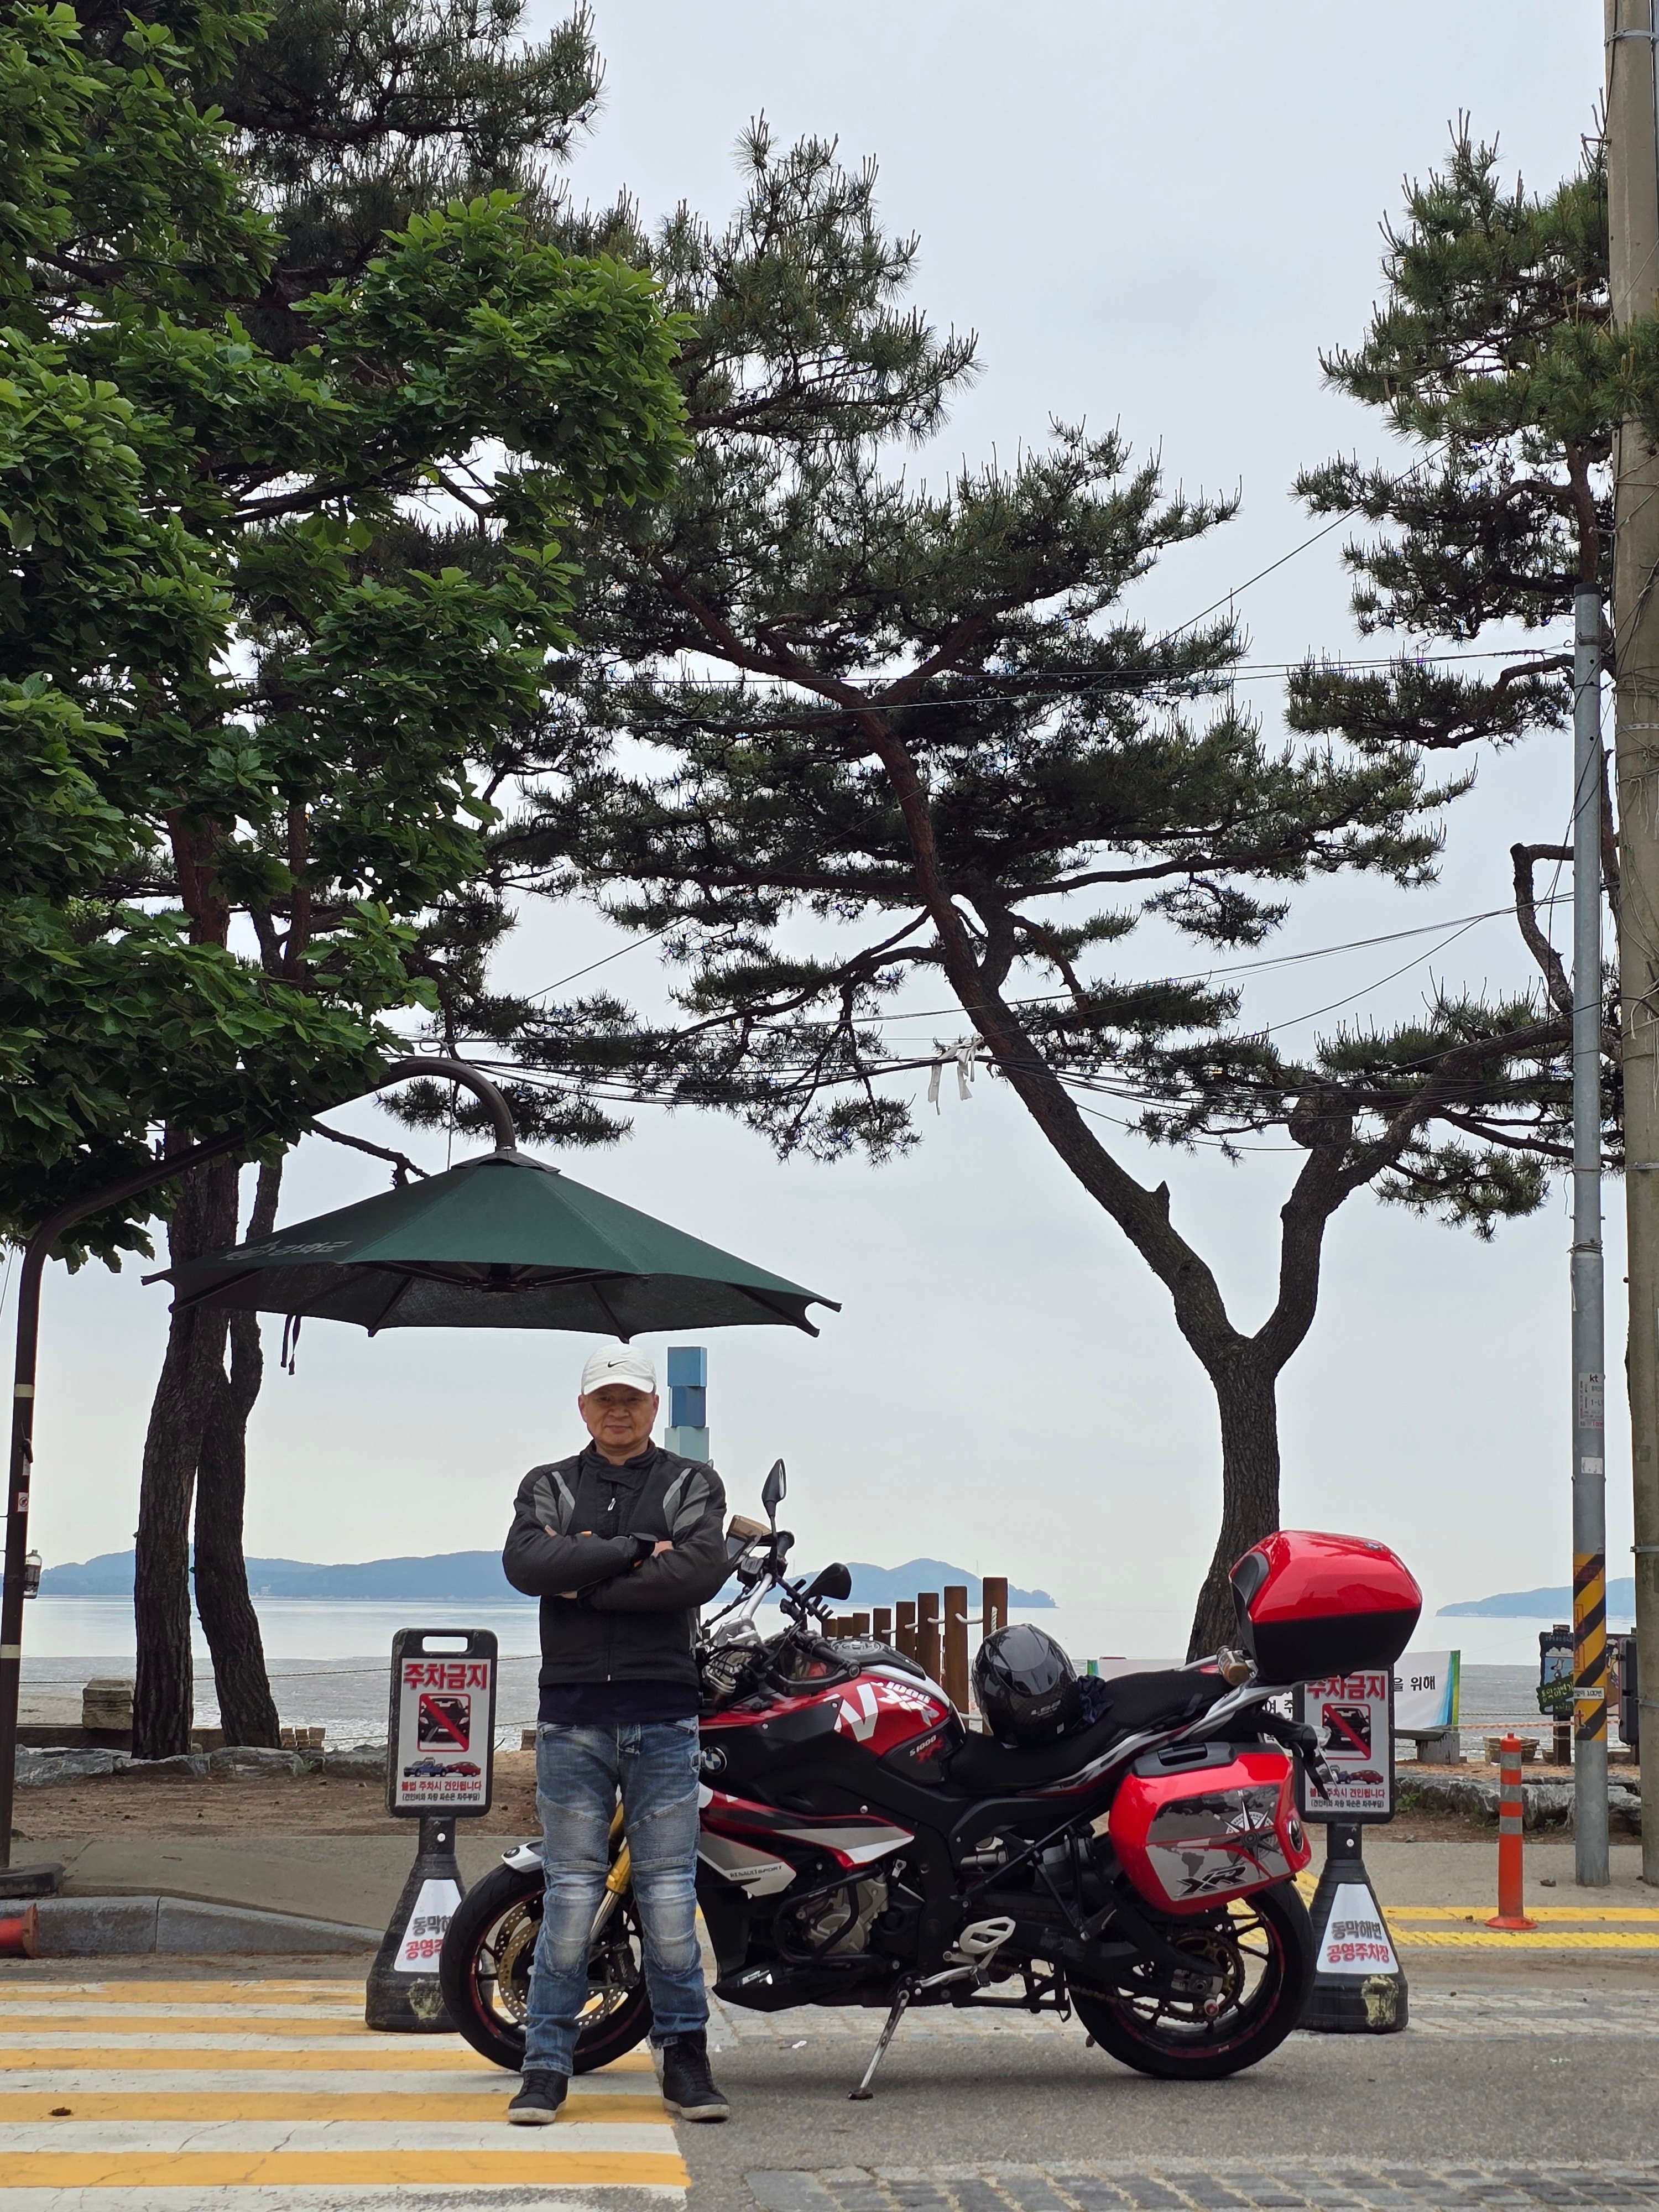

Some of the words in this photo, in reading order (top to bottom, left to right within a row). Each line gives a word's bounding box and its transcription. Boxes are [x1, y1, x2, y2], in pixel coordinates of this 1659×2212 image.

[1589, 1374, 1598, 1383] kt
[403, 1663, 488, 1690] 주차금지
[1410, 1676, 1436, 1692] 위해
[1307, 1674, 1386, 1701] 주차금지
[910, 1749, 916, 1757] S
[916, 1735, 937, 1753] 1000
[401, 1780, 416, 1791] 불법
[419, 1780, 442, 1791] 주차시
[444, 1780, 482, 1791] 견인됩니다
[1350, 1788, 1385, 1798] 견인됩니다
[758, 1865, 782, 1874] SPORT
[1175, 1865, 1248, 1897] XR
[1331, 1920, 1383, 1940] 동막해변
[1327, 1943, 1390, 1963] 공영주차장
